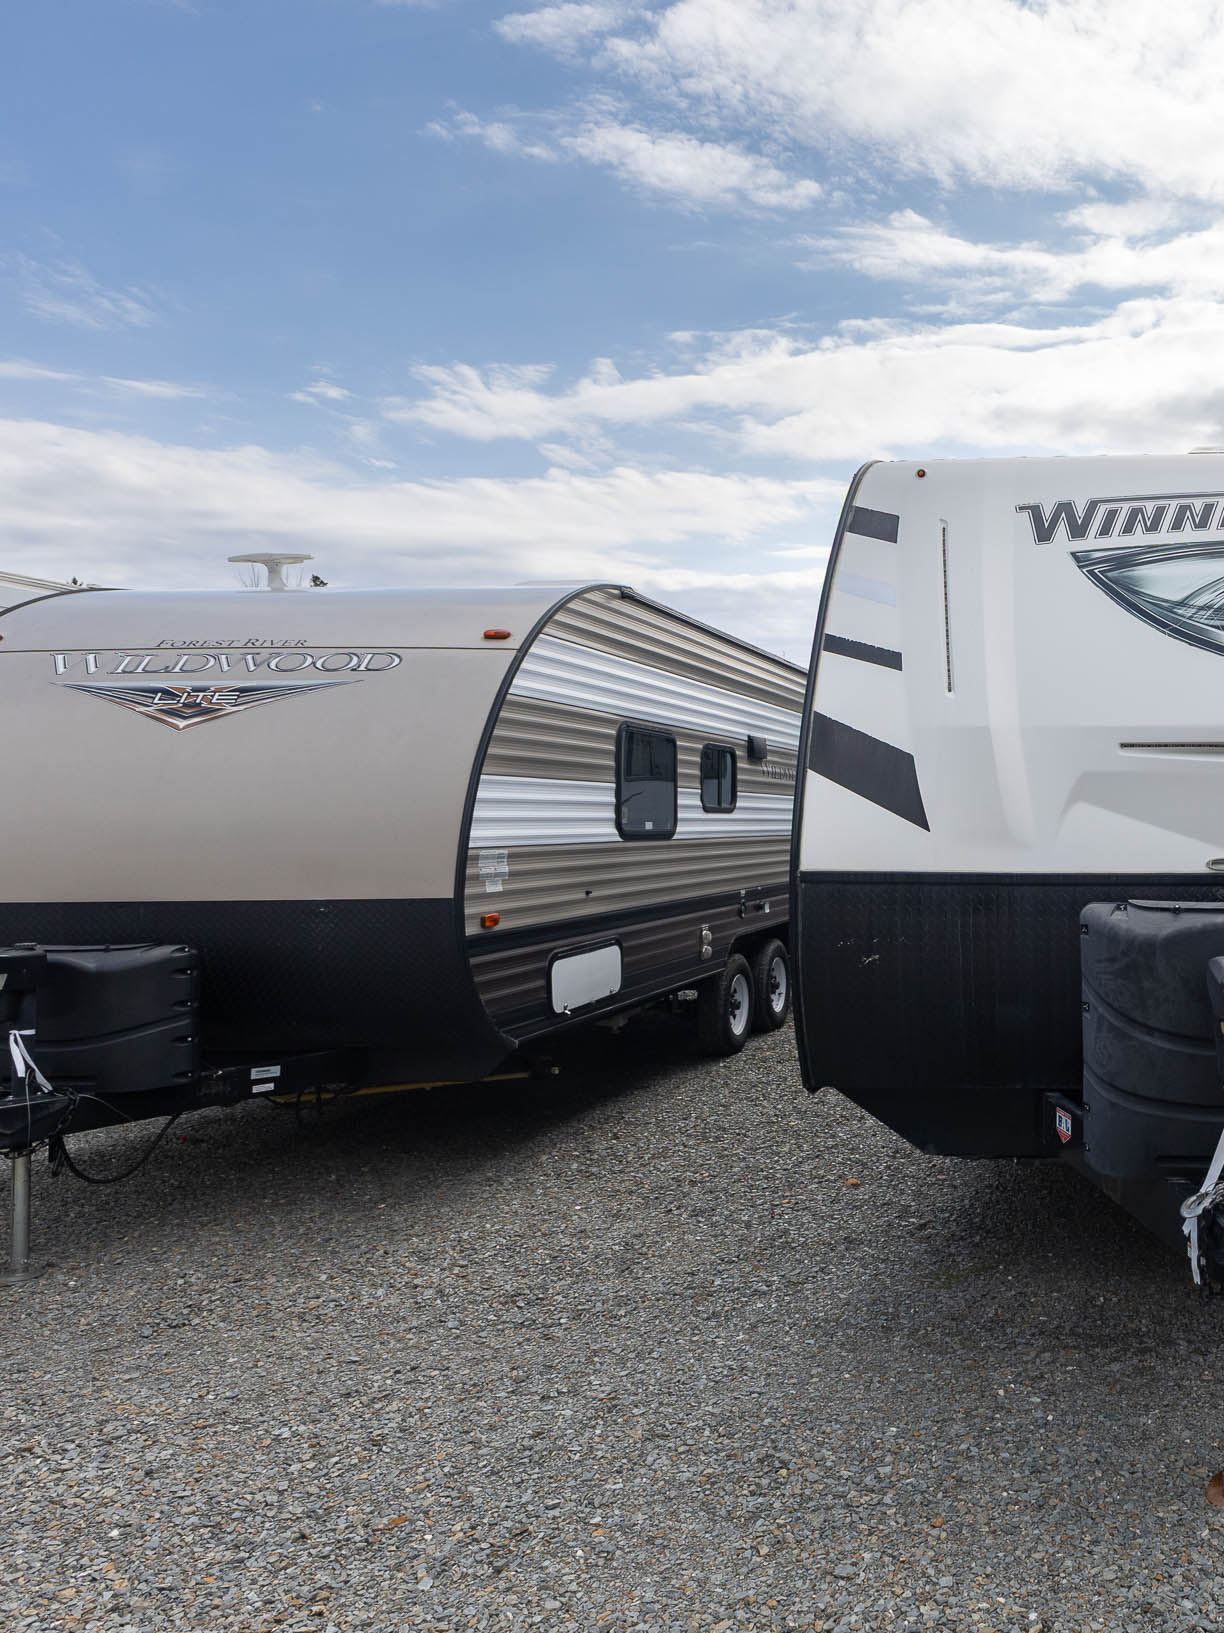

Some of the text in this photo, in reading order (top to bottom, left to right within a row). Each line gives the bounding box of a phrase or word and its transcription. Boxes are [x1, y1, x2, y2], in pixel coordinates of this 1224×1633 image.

[155, 638, 308, 648] FOREST RIVER
[50, 652, 403, 675] WILDWOOD
[152, 691, 241, 704] LITE
[761, 760, 796, 781] WILDW
